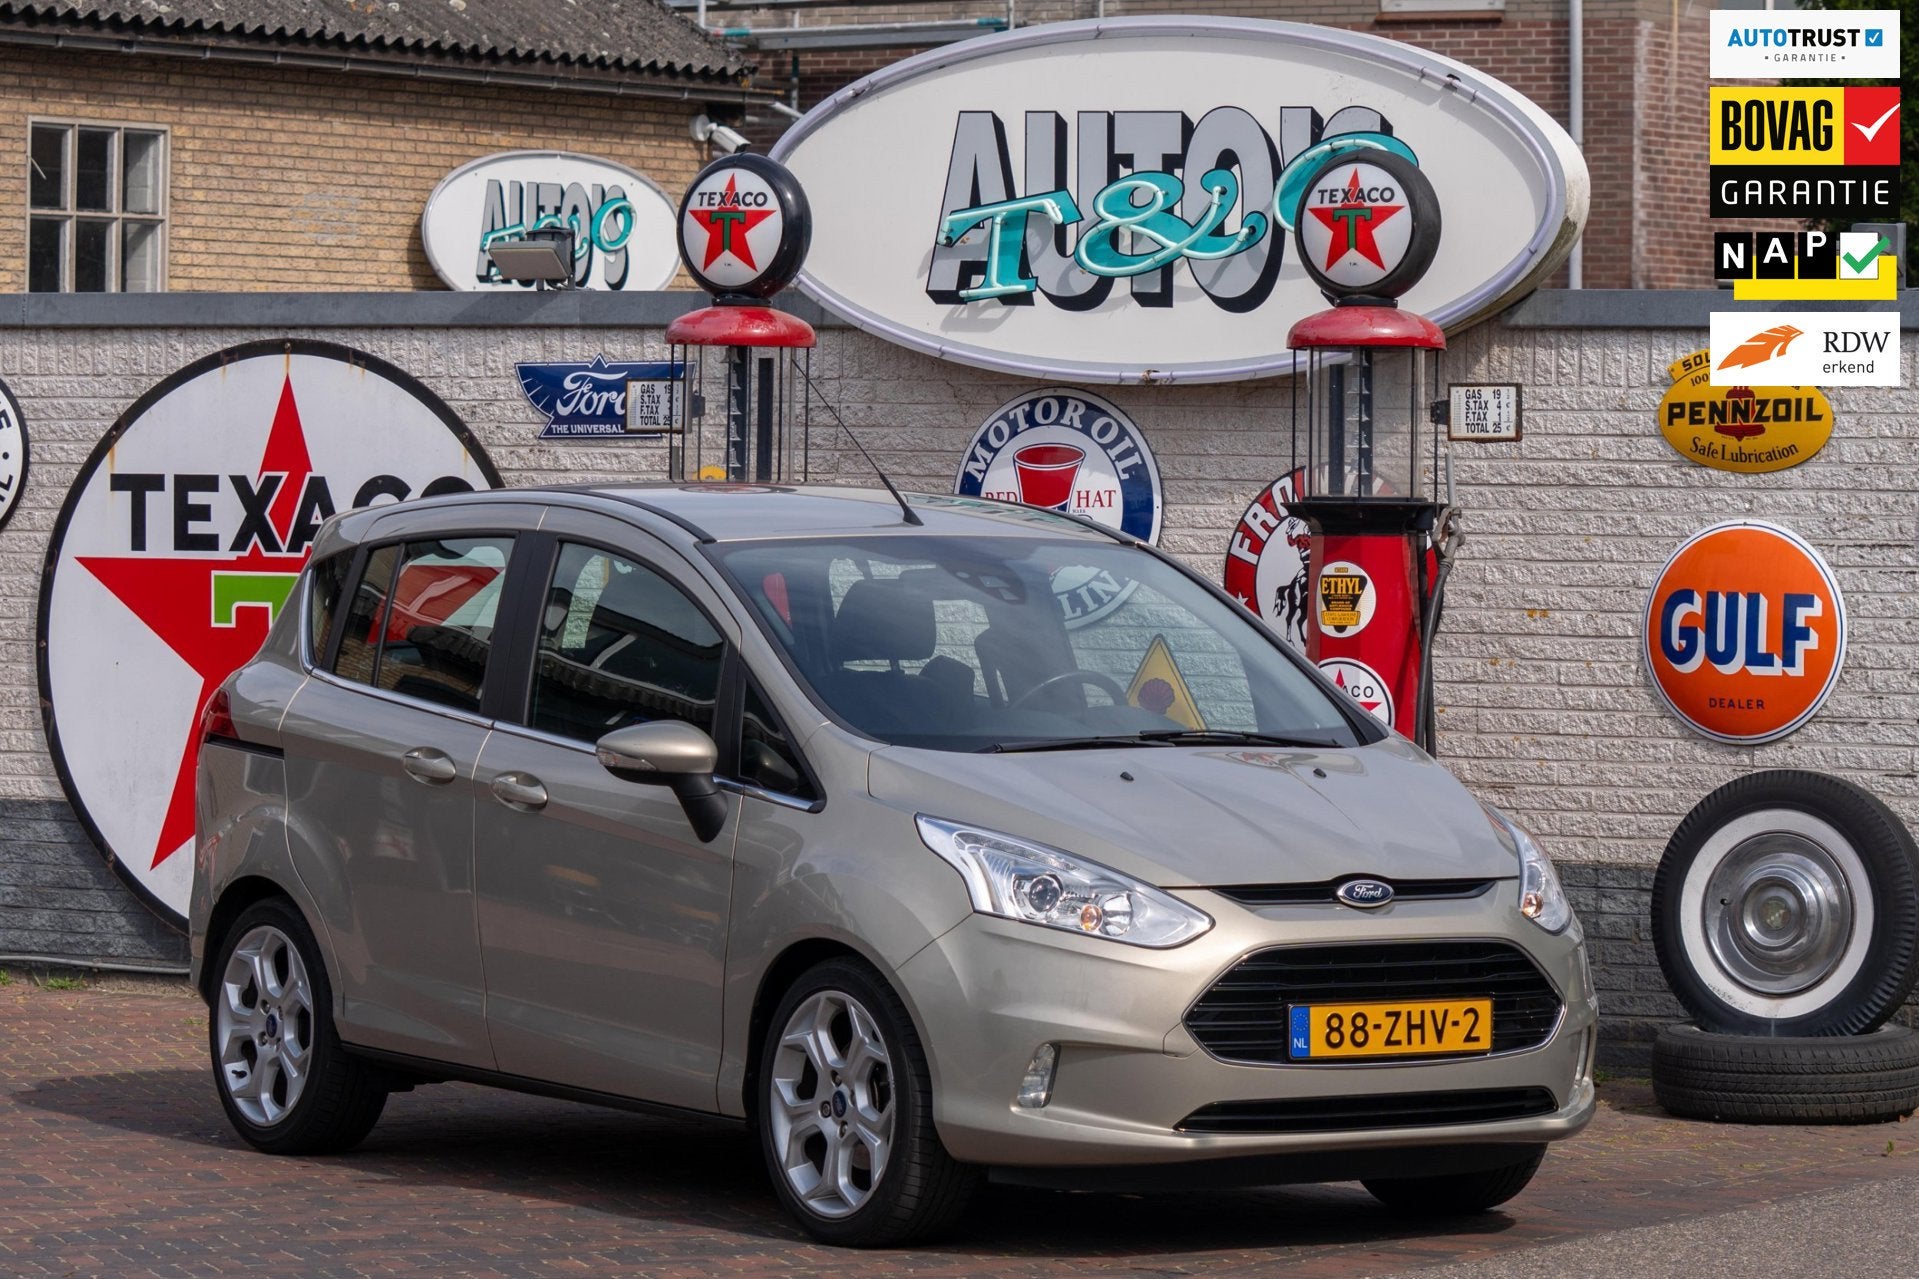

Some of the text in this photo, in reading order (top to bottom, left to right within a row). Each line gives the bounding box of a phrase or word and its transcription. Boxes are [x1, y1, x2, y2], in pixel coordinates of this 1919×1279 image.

[698, 191, 768, 207] TEXACO
[1317, 187, 1395, 204] TEXACO
[926, 106, 1393, 313] AUTO'
[641, 384, 655, 394] GAS
[1465, 389, 1482, 399] GAS
[1492, 389, 1501, 399] 19
[640, 395, 661, 404] S.TAX
[1465, 400, 1488, 410] S.TAX
[1465, 412, 1487, 421] F.TAX
[1667, 398, 1824, 426] PENNZOIL
[640, 416, 661, 425] TOTAL
[1465, 423, 1489, 433] TOTAL
[1492, 423, 1502, 433] 25
[551, 424, 625, 434] THE UNIVERSAL
[965, 398, 1143, 482] MOTOR OIL
[1690, 436, 1799, 463] Safe Lubrication
[1076, 490, 1116, 508] HAT
[110, 473, 475, 552] TEXA
[1321, 577, 1362, 594] ETHYL
[1660, 588, 1823, 677] GULF
[1709, 697, 1765, 709] DEALER
[1352, 884, 1383, 900] Ford
[1325, 1007, 1481, 1049] 88-ZHV-2
[1293, 1037, 1308, 1049] NL
